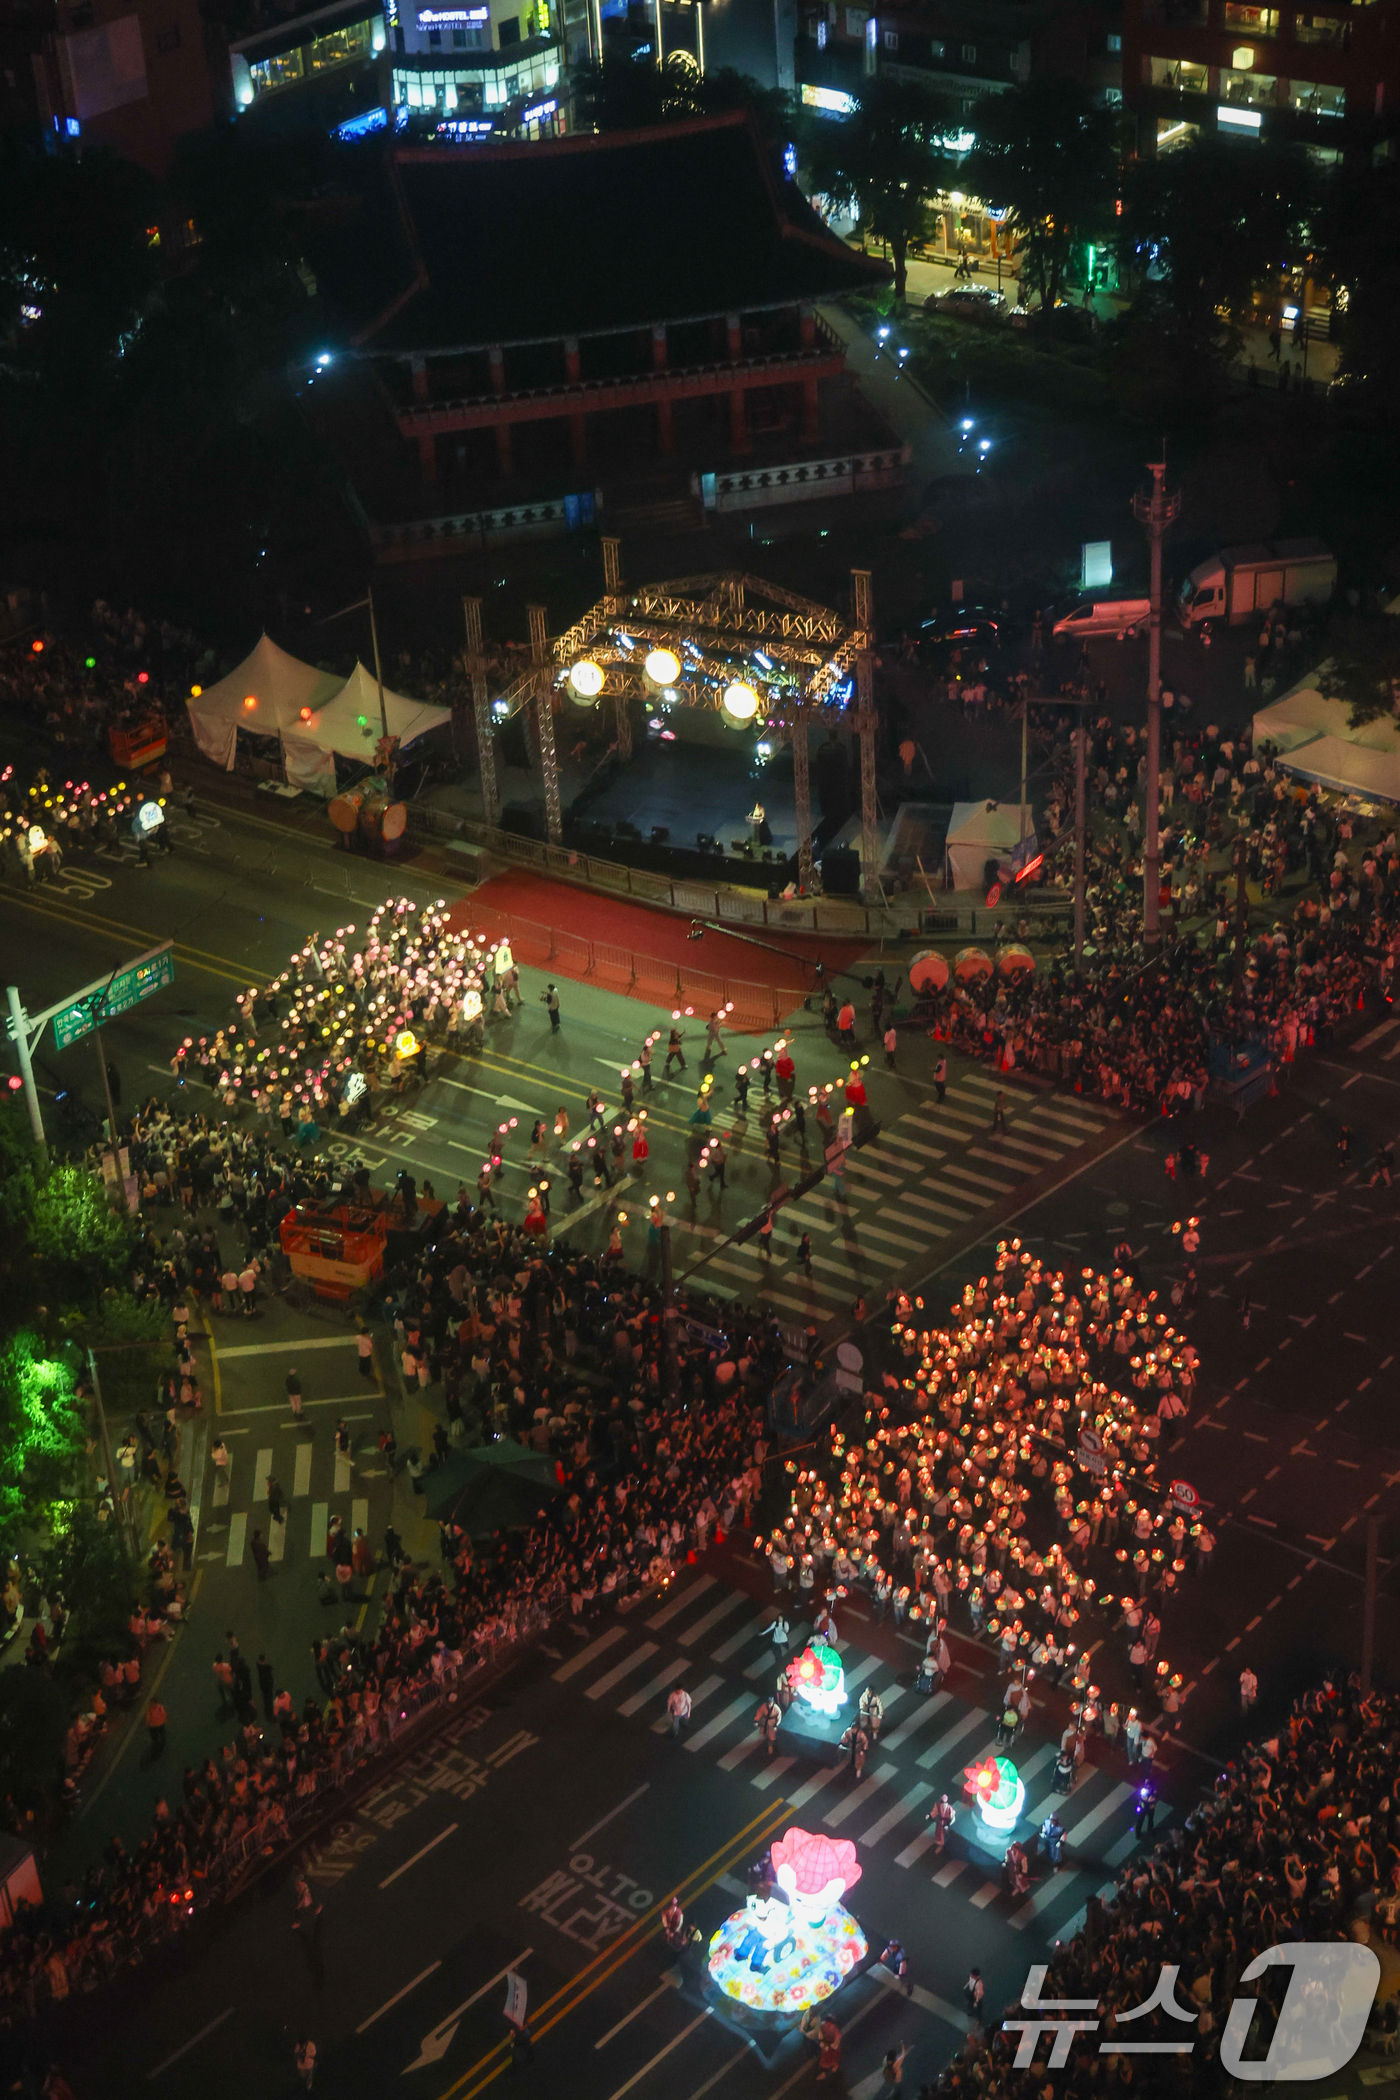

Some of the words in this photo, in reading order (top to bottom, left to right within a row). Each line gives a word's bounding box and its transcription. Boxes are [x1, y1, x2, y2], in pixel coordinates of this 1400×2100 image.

[40, 866, 112, 899] 50
[1176, 1484, 1194, 1502] 50
[517, 1853, 654, 1953] 종로구청
